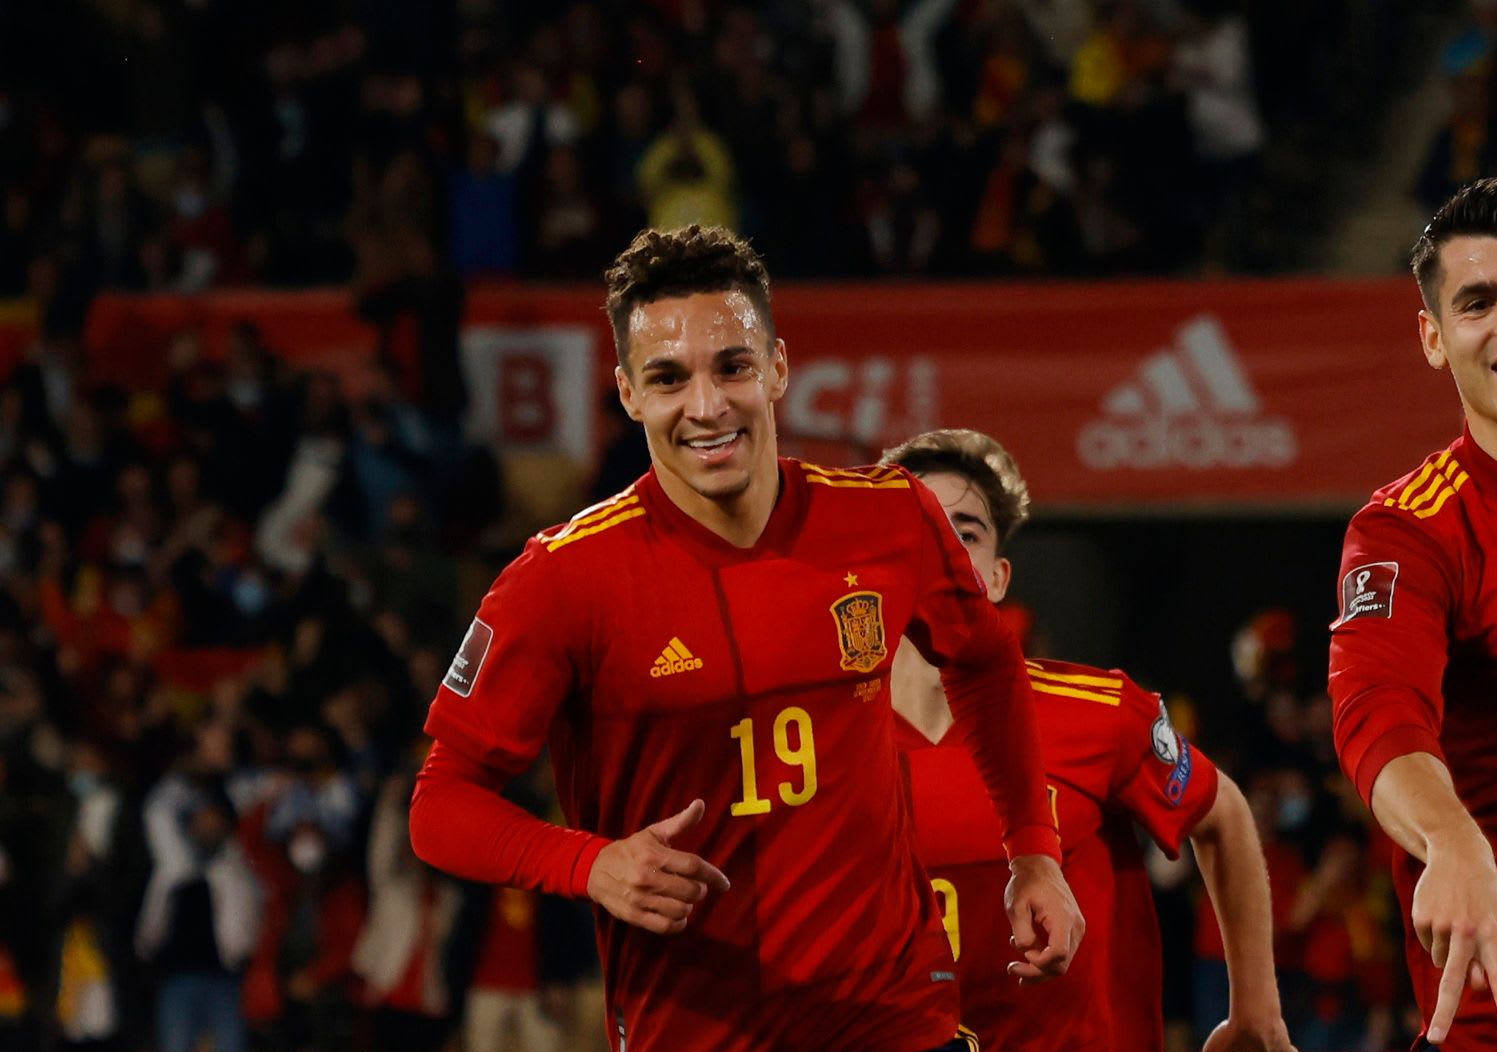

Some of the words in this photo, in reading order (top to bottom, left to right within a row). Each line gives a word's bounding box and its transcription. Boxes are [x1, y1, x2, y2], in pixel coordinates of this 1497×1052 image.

[1076, 412, 1298, 470] adidas
[650, 657, 704, 678] adidas
[730, 706, 818, 817] 19
